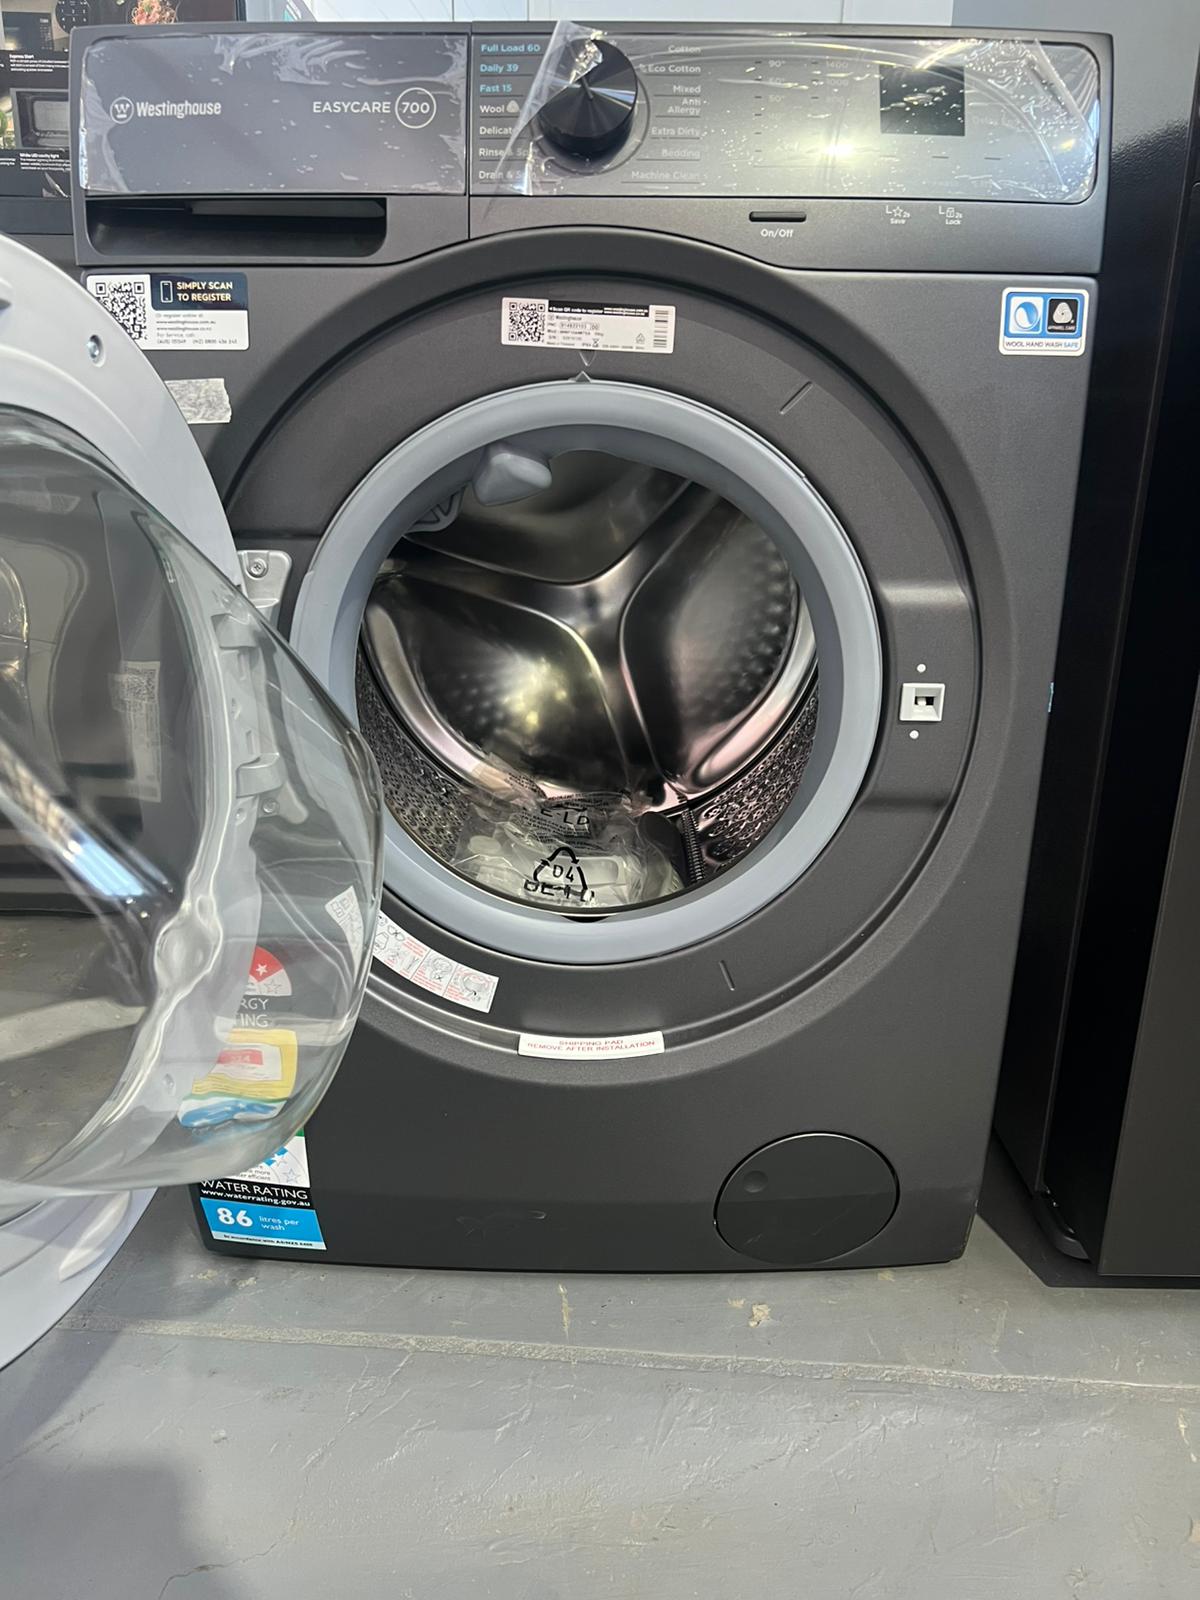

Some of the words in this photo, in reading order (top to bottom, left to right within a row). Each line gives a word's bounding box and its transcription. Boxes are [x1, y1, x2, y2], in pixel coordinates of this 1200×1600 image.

[481, 44, 499, 52] Full
[501, 44, 525, 52] Load
[527, 44, 541, 52] 60
[668, 45, 701, 53] Cotton
[480, 64, 504, 73] Daily
[506, 63, 519, 72] 39
[648, 64, 666, 73] Eco
[668, 64, 701, 73] Cotton
[480, 84, 500, 92] Fast
[502, 83, 512, 92] 15
[673, 85, 701, 93] Mixed
[136, 100, 222, 119] Westinghouse
[313, 101, 391, 113] EASYCARE
[401, 101, 430, 114] 700
[480, 105, 505, 113] Wool
[668, 106, 701, 116] Allergy
[651, 126, 676, 136] Extra
[631, 171, 671, 180] Machine
[760, 228, 794, 239] On/Off
[176, 281, 207, 290] SIMPLY
[208, 281, 233, 290] SCAN
[176, 292, 190, 301] TO
[191, 292, 232, 302] REGISTER
[1006, 340, 1025, 348] WOOL
[1063, 341, 1079, 349] SAFE
[241, 998, 269, 1010] RGY
[240, 1013, 269, 1028] ING
[527, 1042, 564, 1051] REMOVE
[596, 1040, 655, 1052] INSTALLATION
[201, 1179, 251, 1194] WATER
[253, 1185, 308, 1200] RATING
[201, 1188, 308, 1207] www.waterrating.gov.au
[217, 1207, 254, 1227] 86
[259, 1215, 282, 1224] litres
[284, 1218, 300, 1226] per
[261, 1223, 286, 1231] wash
